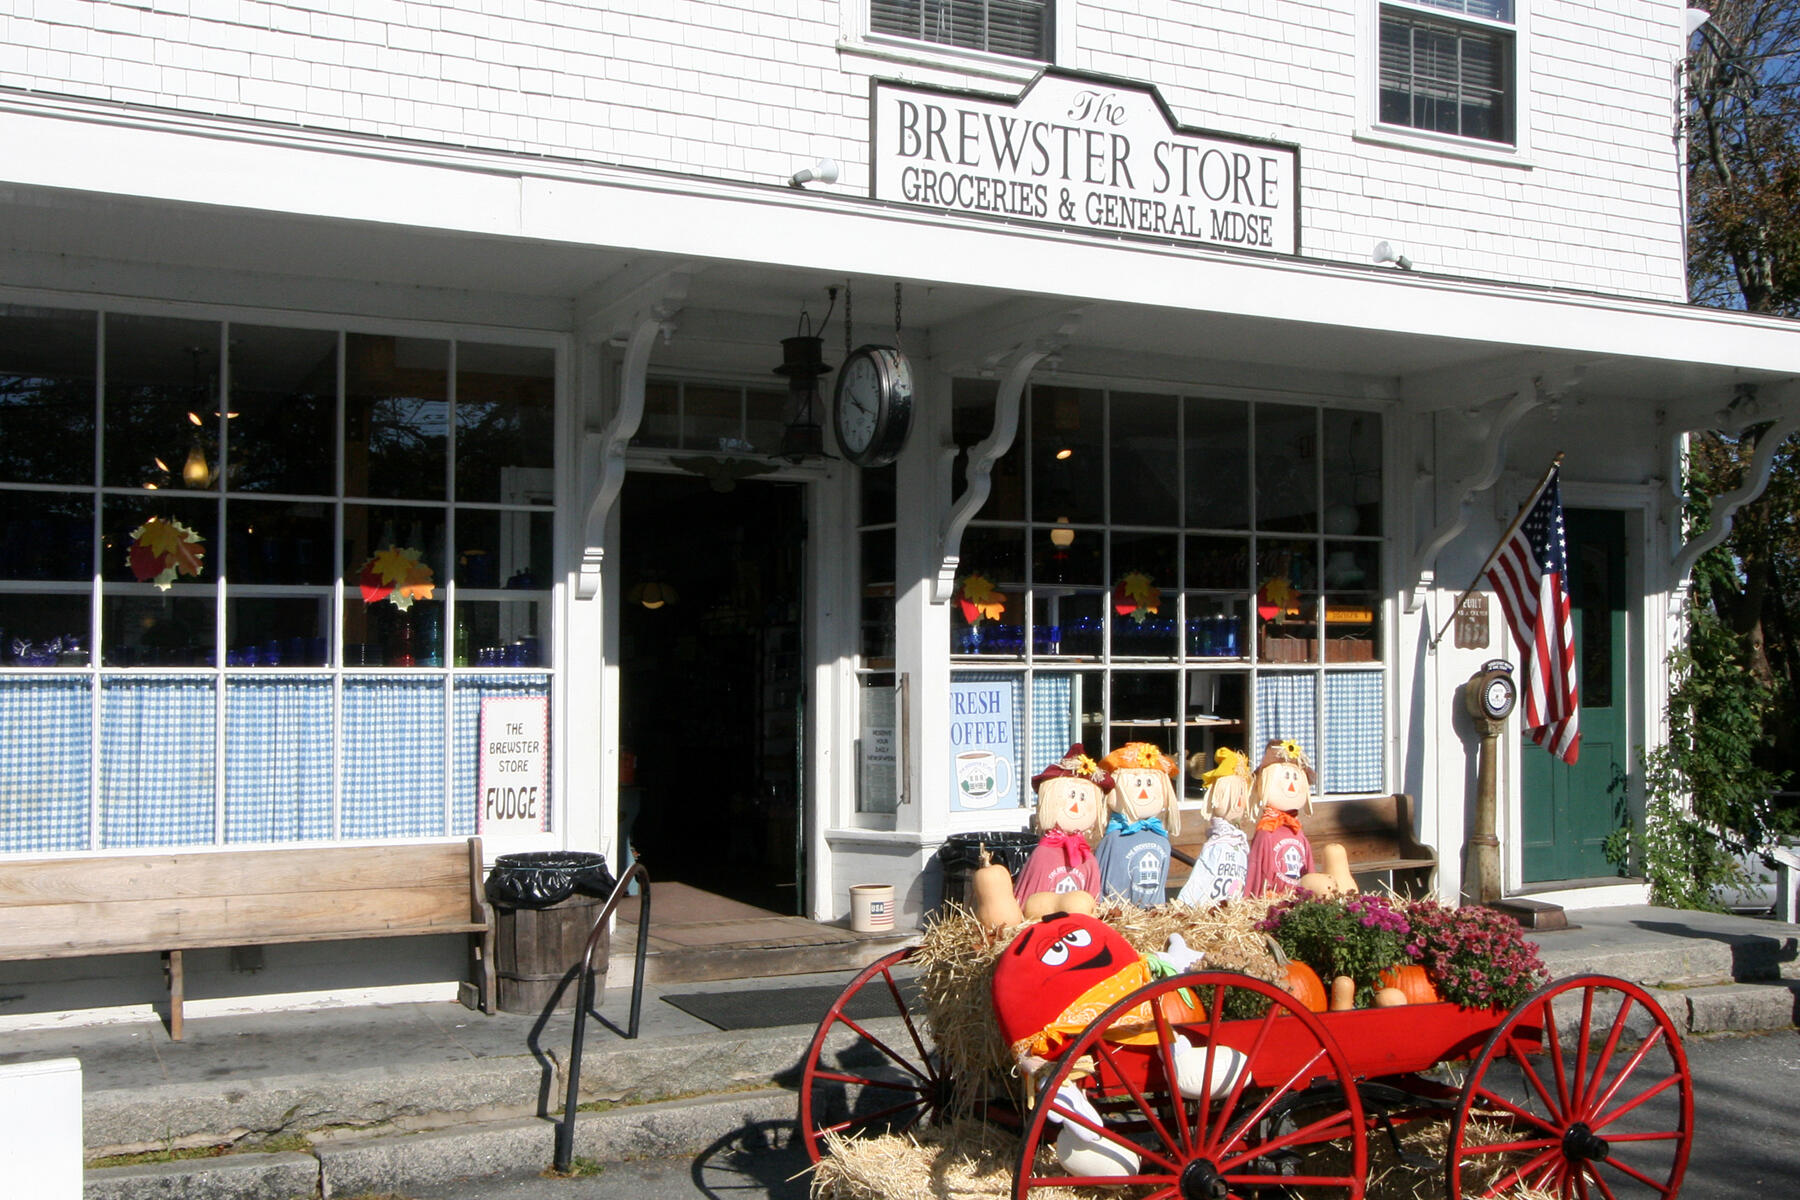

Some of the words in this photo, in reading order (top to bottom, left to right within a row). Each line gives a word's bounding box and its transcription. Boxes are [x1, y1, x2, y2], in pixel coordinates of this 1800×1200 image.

[1067, 89, 1128, 126] The
[895, 99, 1136, 190] BREWSTER
[1153, 140, 1279, 209] STORE
[901, 166, 1048, 218] GROCERIES
[1058, 187, 1076, 222] &
[1085, 191, 1202, 238] GENERAL
[1210, 209, 1273, 248] MDSE
[506, 723, 523, 735] THE
[951, 720, 1009, 746] OFFEE
[489, 741, 539, 754] BREWSTER
[498, 760, 529, 772] STORE
[486, 786, 538, 820] FUDGE
